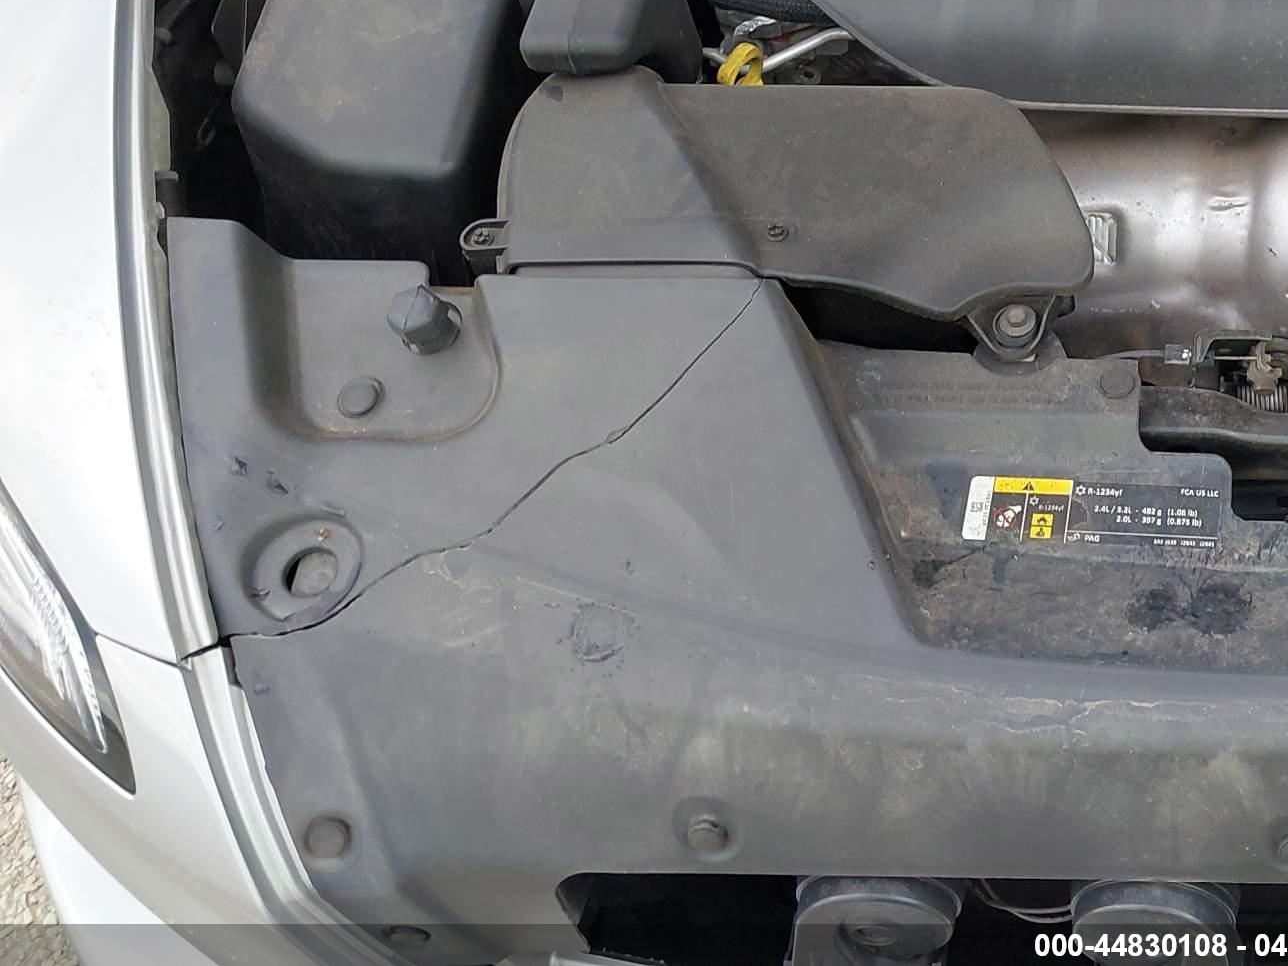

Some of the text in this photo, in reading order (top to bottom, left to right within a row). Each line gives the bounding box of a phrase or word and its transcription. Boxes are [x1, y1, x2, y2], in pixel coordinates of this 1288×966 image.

[1087, 488, 1123, 498] R-1234yf
[1180, 488, 1219, 497] FCA US LLC
[1094, 505, 1110, 513] 2.4L
[1084, 534, 1100, 543] PAG
